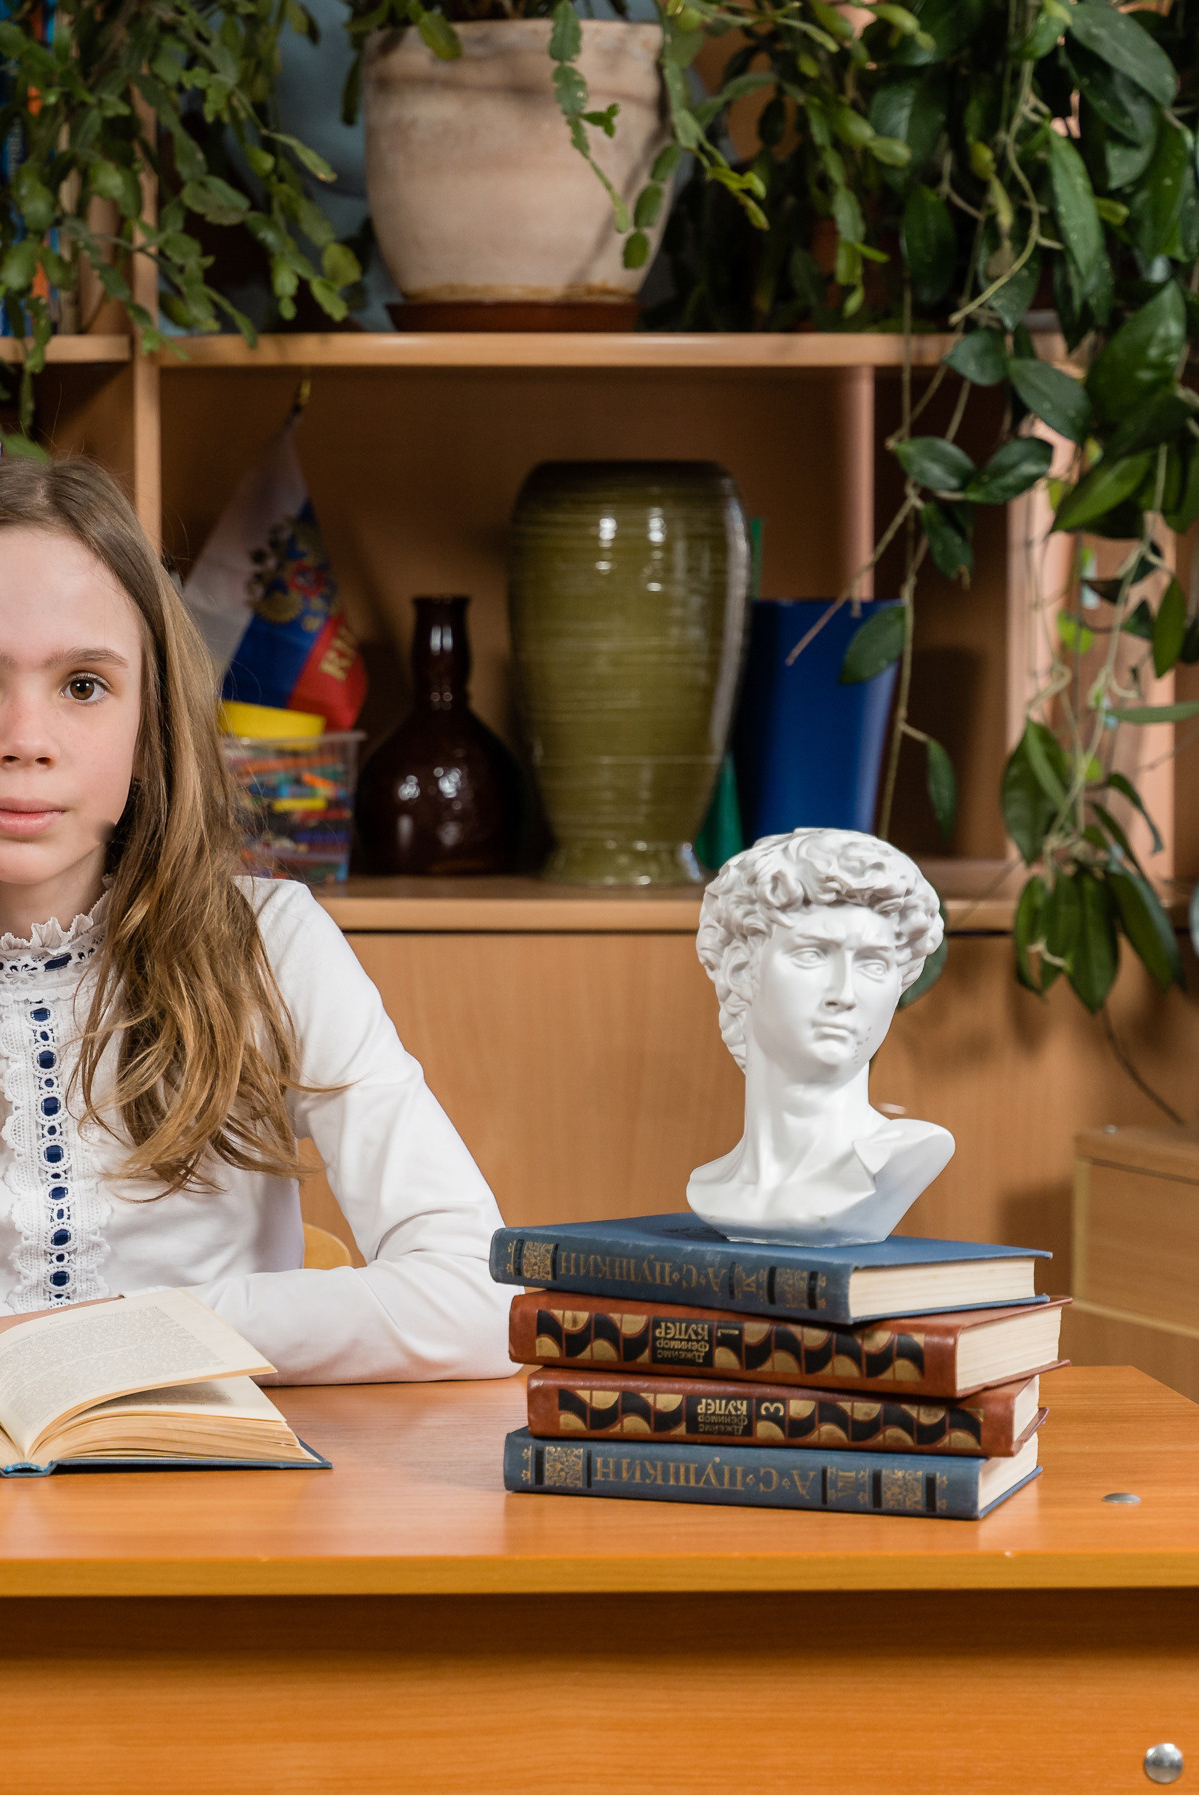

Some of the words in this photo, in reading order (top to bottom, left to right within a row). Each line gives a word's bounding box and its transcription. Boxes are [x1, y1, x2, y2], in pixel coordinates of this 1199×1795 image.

[655, 1322, 709, 1340] КУПЕР
[656, 1338, 709, 1352] Фенимор
[657, 1350, 705, 1363] Джеймс
[697, 1399, 747, 1415] КУПЕР
